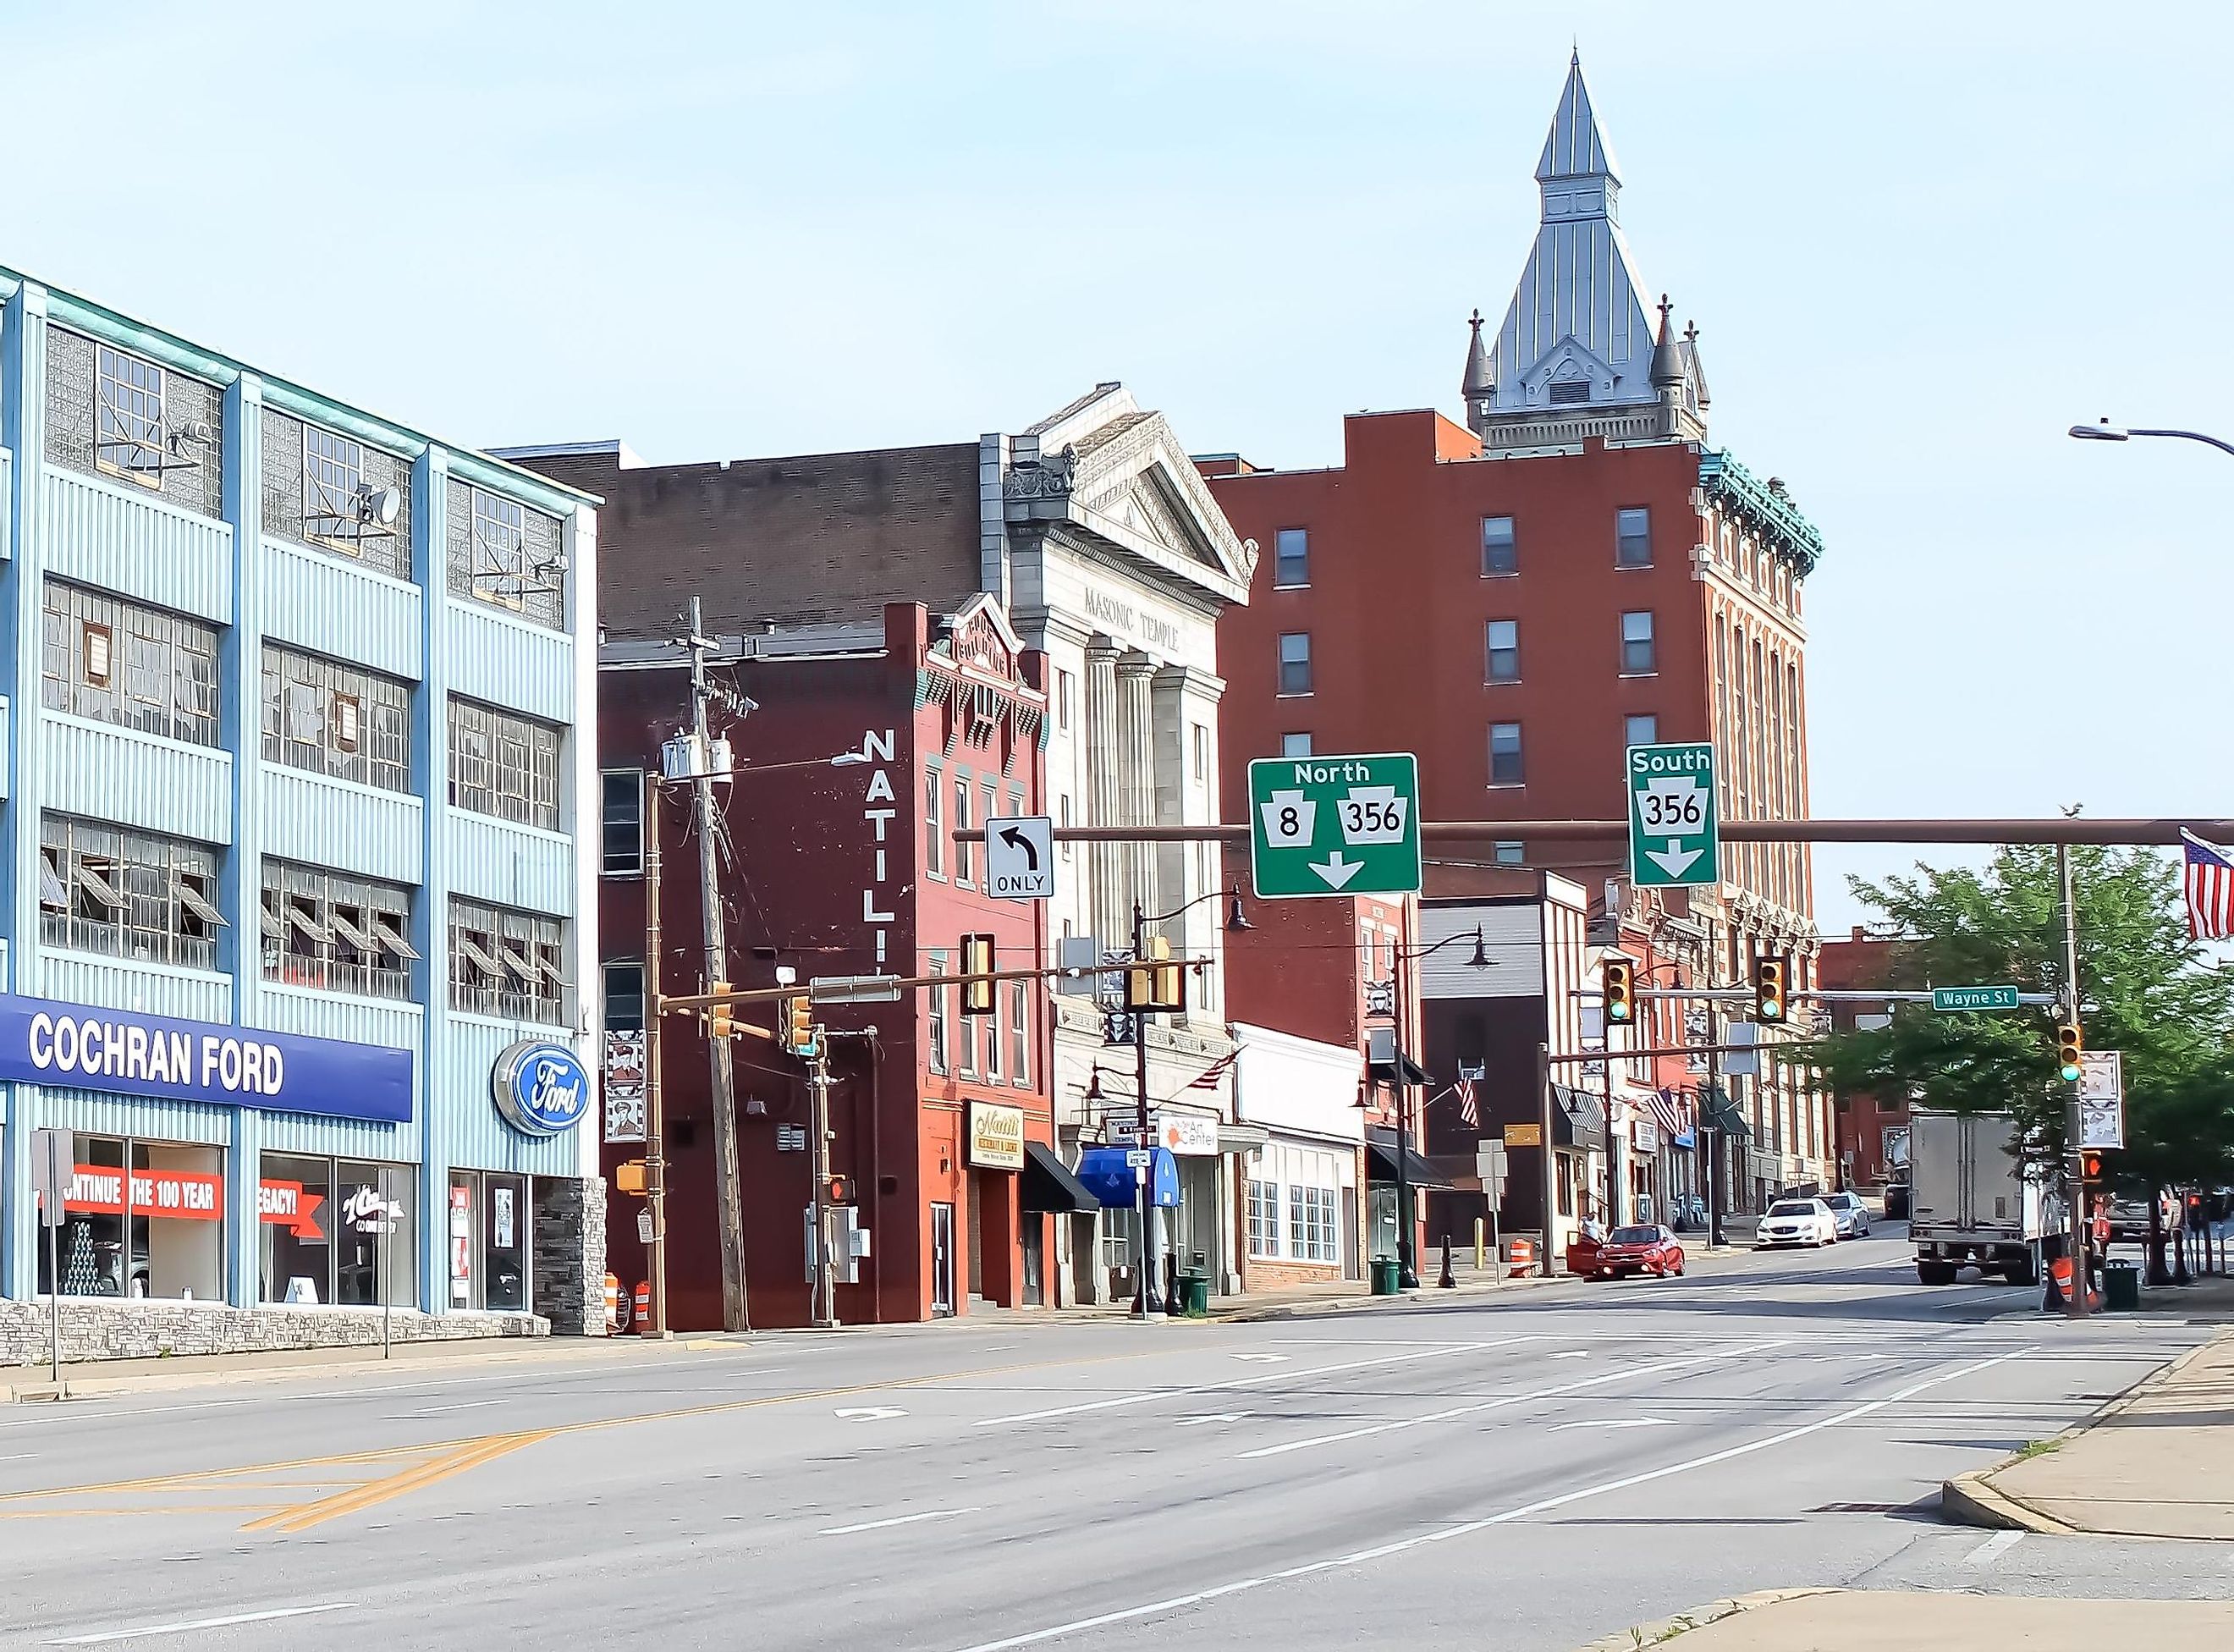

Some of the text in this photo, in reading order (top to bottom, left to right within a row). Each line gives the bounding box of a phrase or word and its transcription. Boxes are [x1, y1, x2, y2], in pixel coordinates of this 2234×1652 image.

[1085, 586, 1180, 653] MASONIC TEMPLE
[1295, 763, 1370, 784] North
[1632, 750, 1709, 773] South
[1279, 801, 1400, 836] 8 356
[1645, 794, 1701, 825] 356
[863, 730, 896, 962] NATILI
[998, 876, 1044, 891] ONLY
[1942, 990, 2010, 1007] Wayne St
[28, 1011, 284, 1096] COCHRAN FORD
[530, 1060, 581, 1115] Ford
[63, 1173, 215, 1210] NTINUE THE 100 YEAR
[260, 1187, 297, 1216] EGACY!
